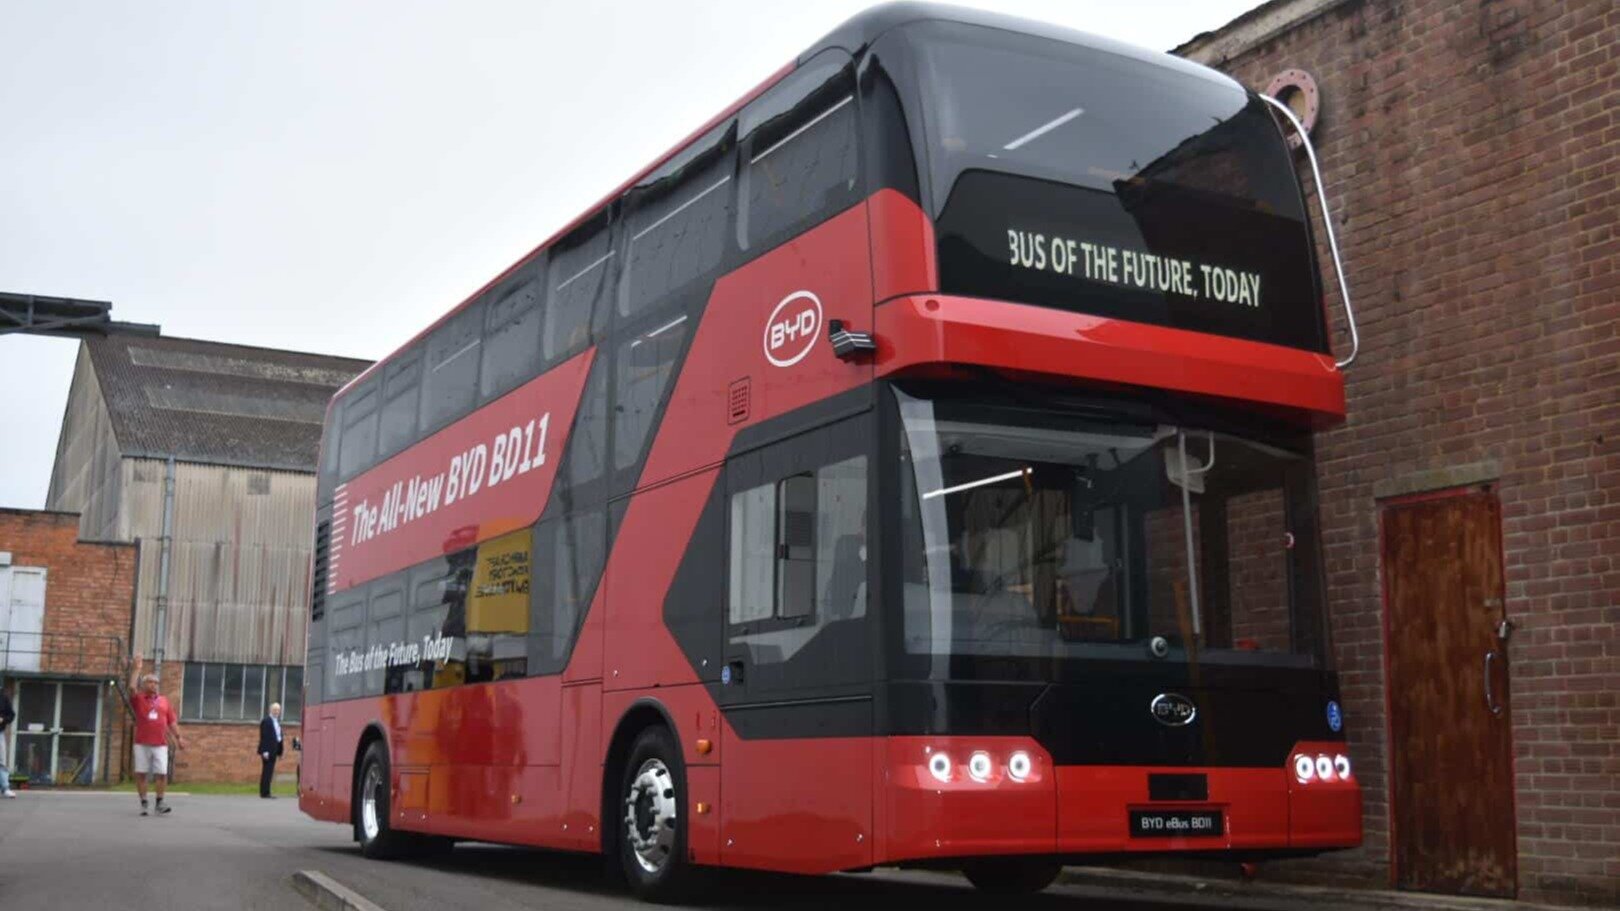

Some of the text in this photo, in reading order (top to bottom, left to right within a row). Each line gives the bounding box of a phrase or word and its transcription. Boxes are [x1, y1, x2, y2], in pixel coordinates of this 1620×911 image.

[1007, 229, 1260, 307] BUS OF THE FUTURE, TODAY
[770, 308, 816, 350] BYD
[351, 411, 550, 546] The All-New BYD BD11
[335, 631, 454, 676] The Bus of the Future, Today
[1141, 816, 1163, 829] BYD
[1165, 816, 1189, 829] eBus
